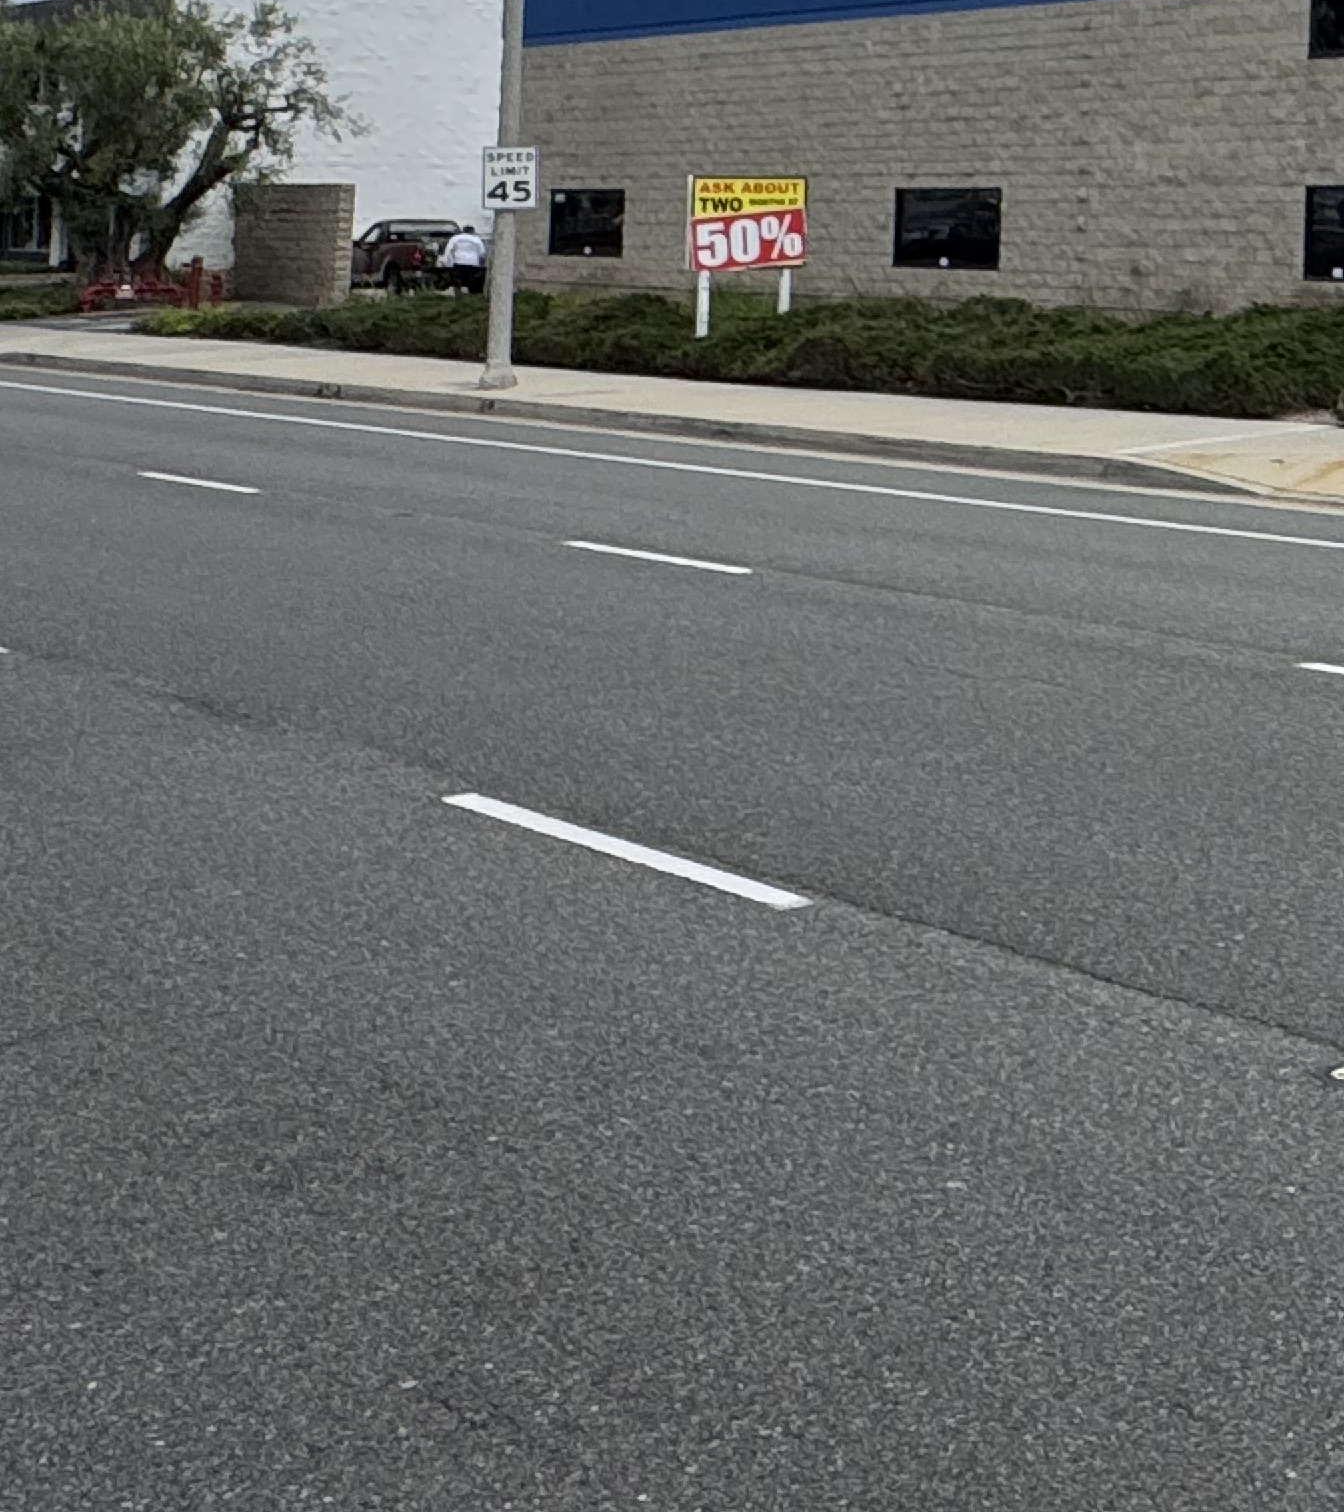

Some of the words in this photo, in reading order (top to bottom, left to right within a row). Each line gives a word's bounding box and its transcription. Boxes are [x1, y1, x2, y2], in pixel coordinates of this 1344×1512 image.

[487, 152, 535, 163] SPEED
[490, 166, 530, 177] LIMIT
[487, 180, 531, 202] 45
[698, 182, 736, 194] ASK
[740, 181, 800, 194] ABOUT
[698, 196, 744, 213] TWO
[696, 213, 803, 267] 50%
